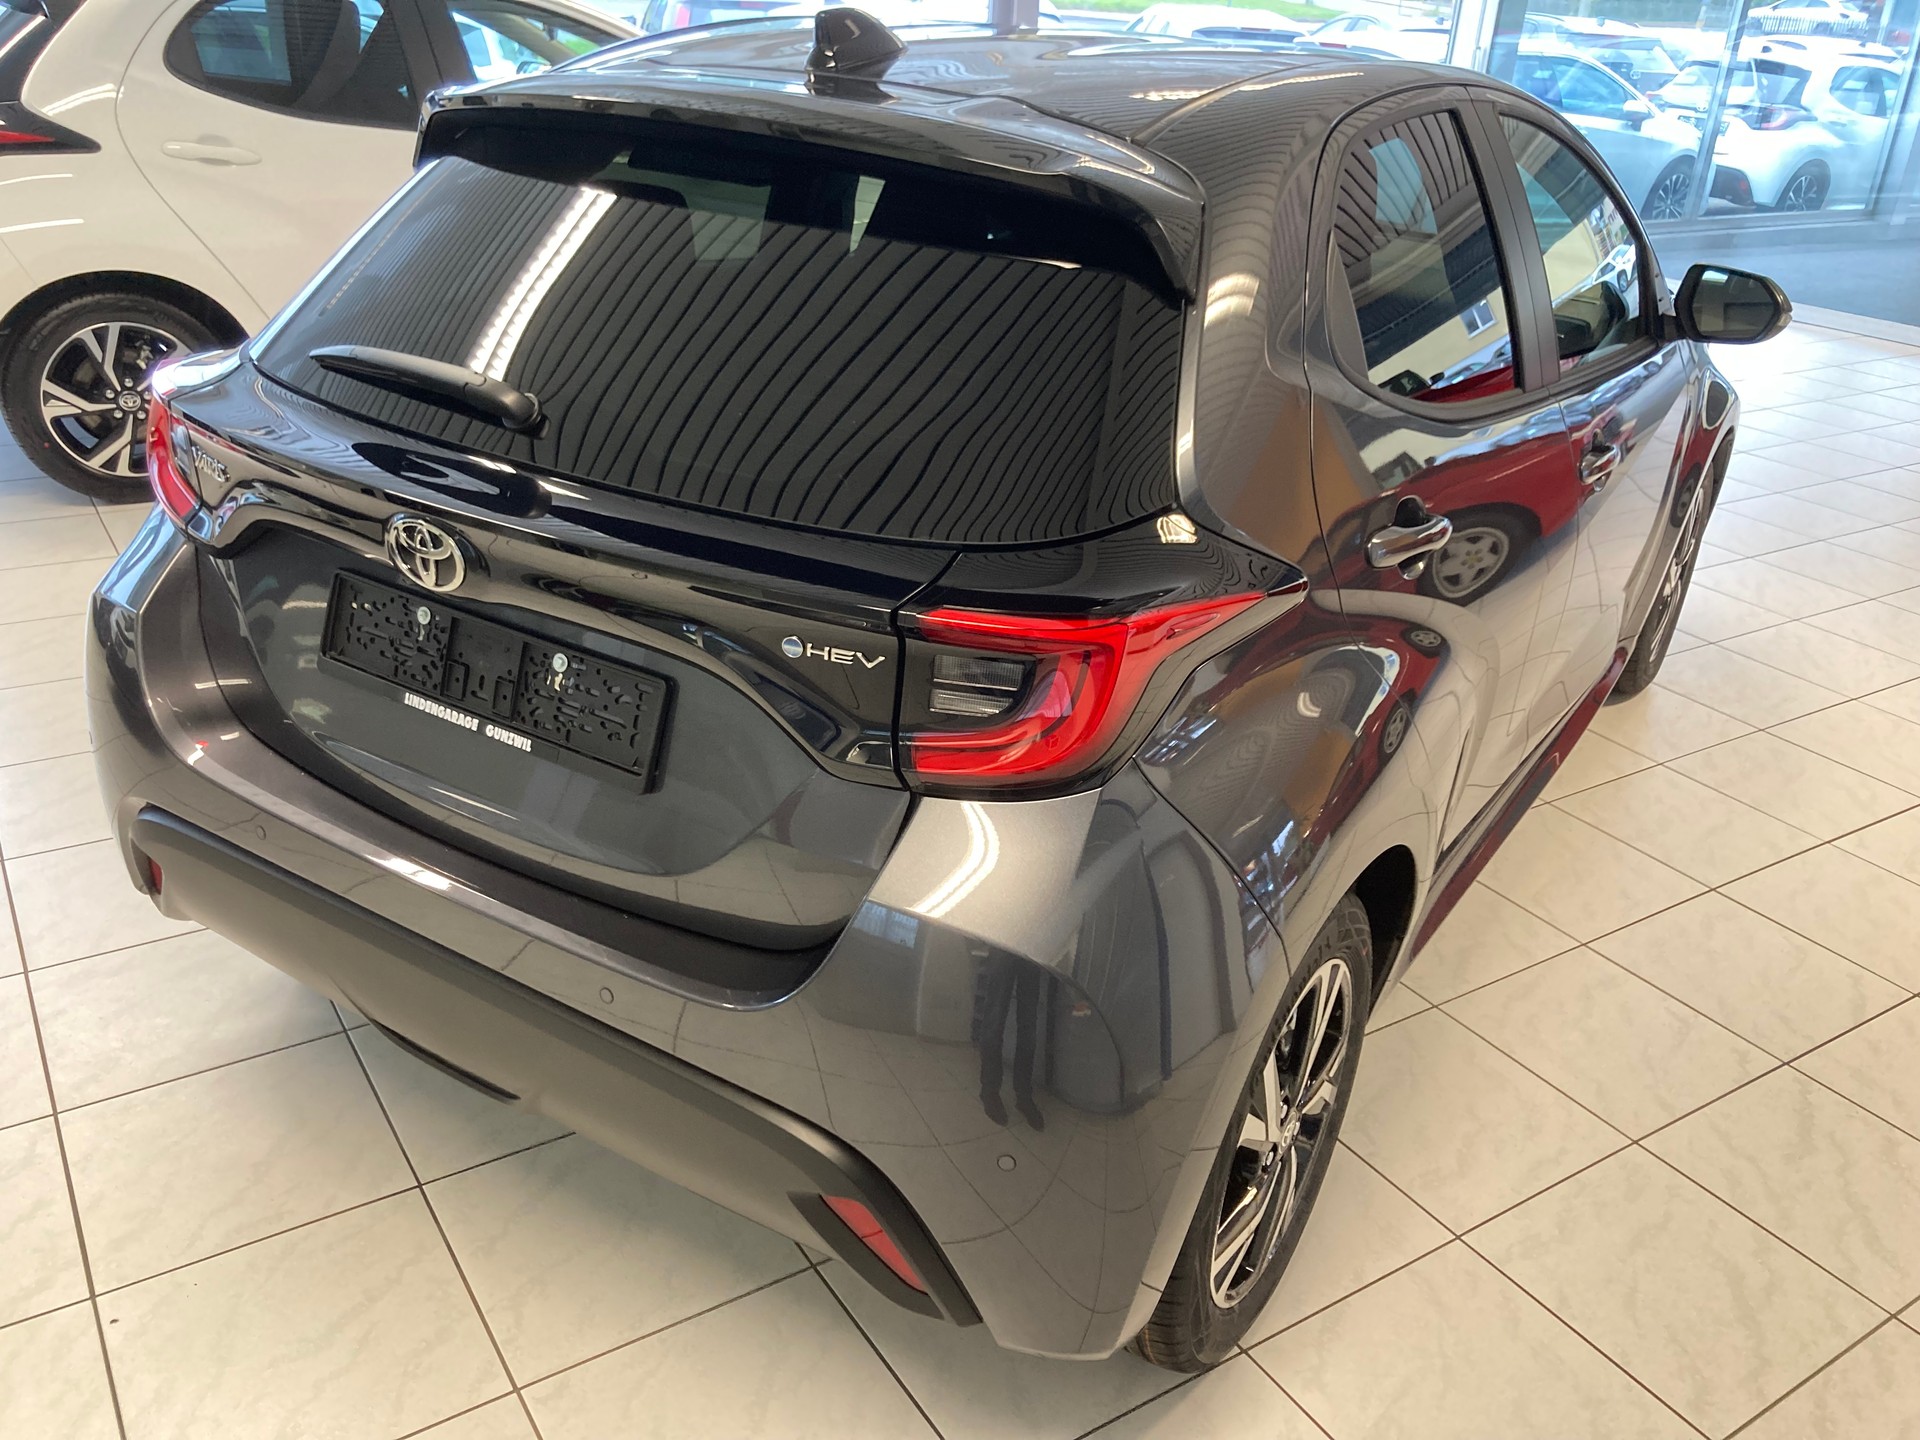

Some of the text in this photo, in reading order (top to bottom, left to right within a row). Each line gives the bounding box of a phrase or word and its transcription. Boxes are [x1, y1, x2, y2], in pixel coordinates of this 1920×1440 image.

[191, 446, 229, 482] YARIS
[806, 643, 886, 668] HEV
[405, 692, 531, 752] LINDENGARAGE GUNZWIL
